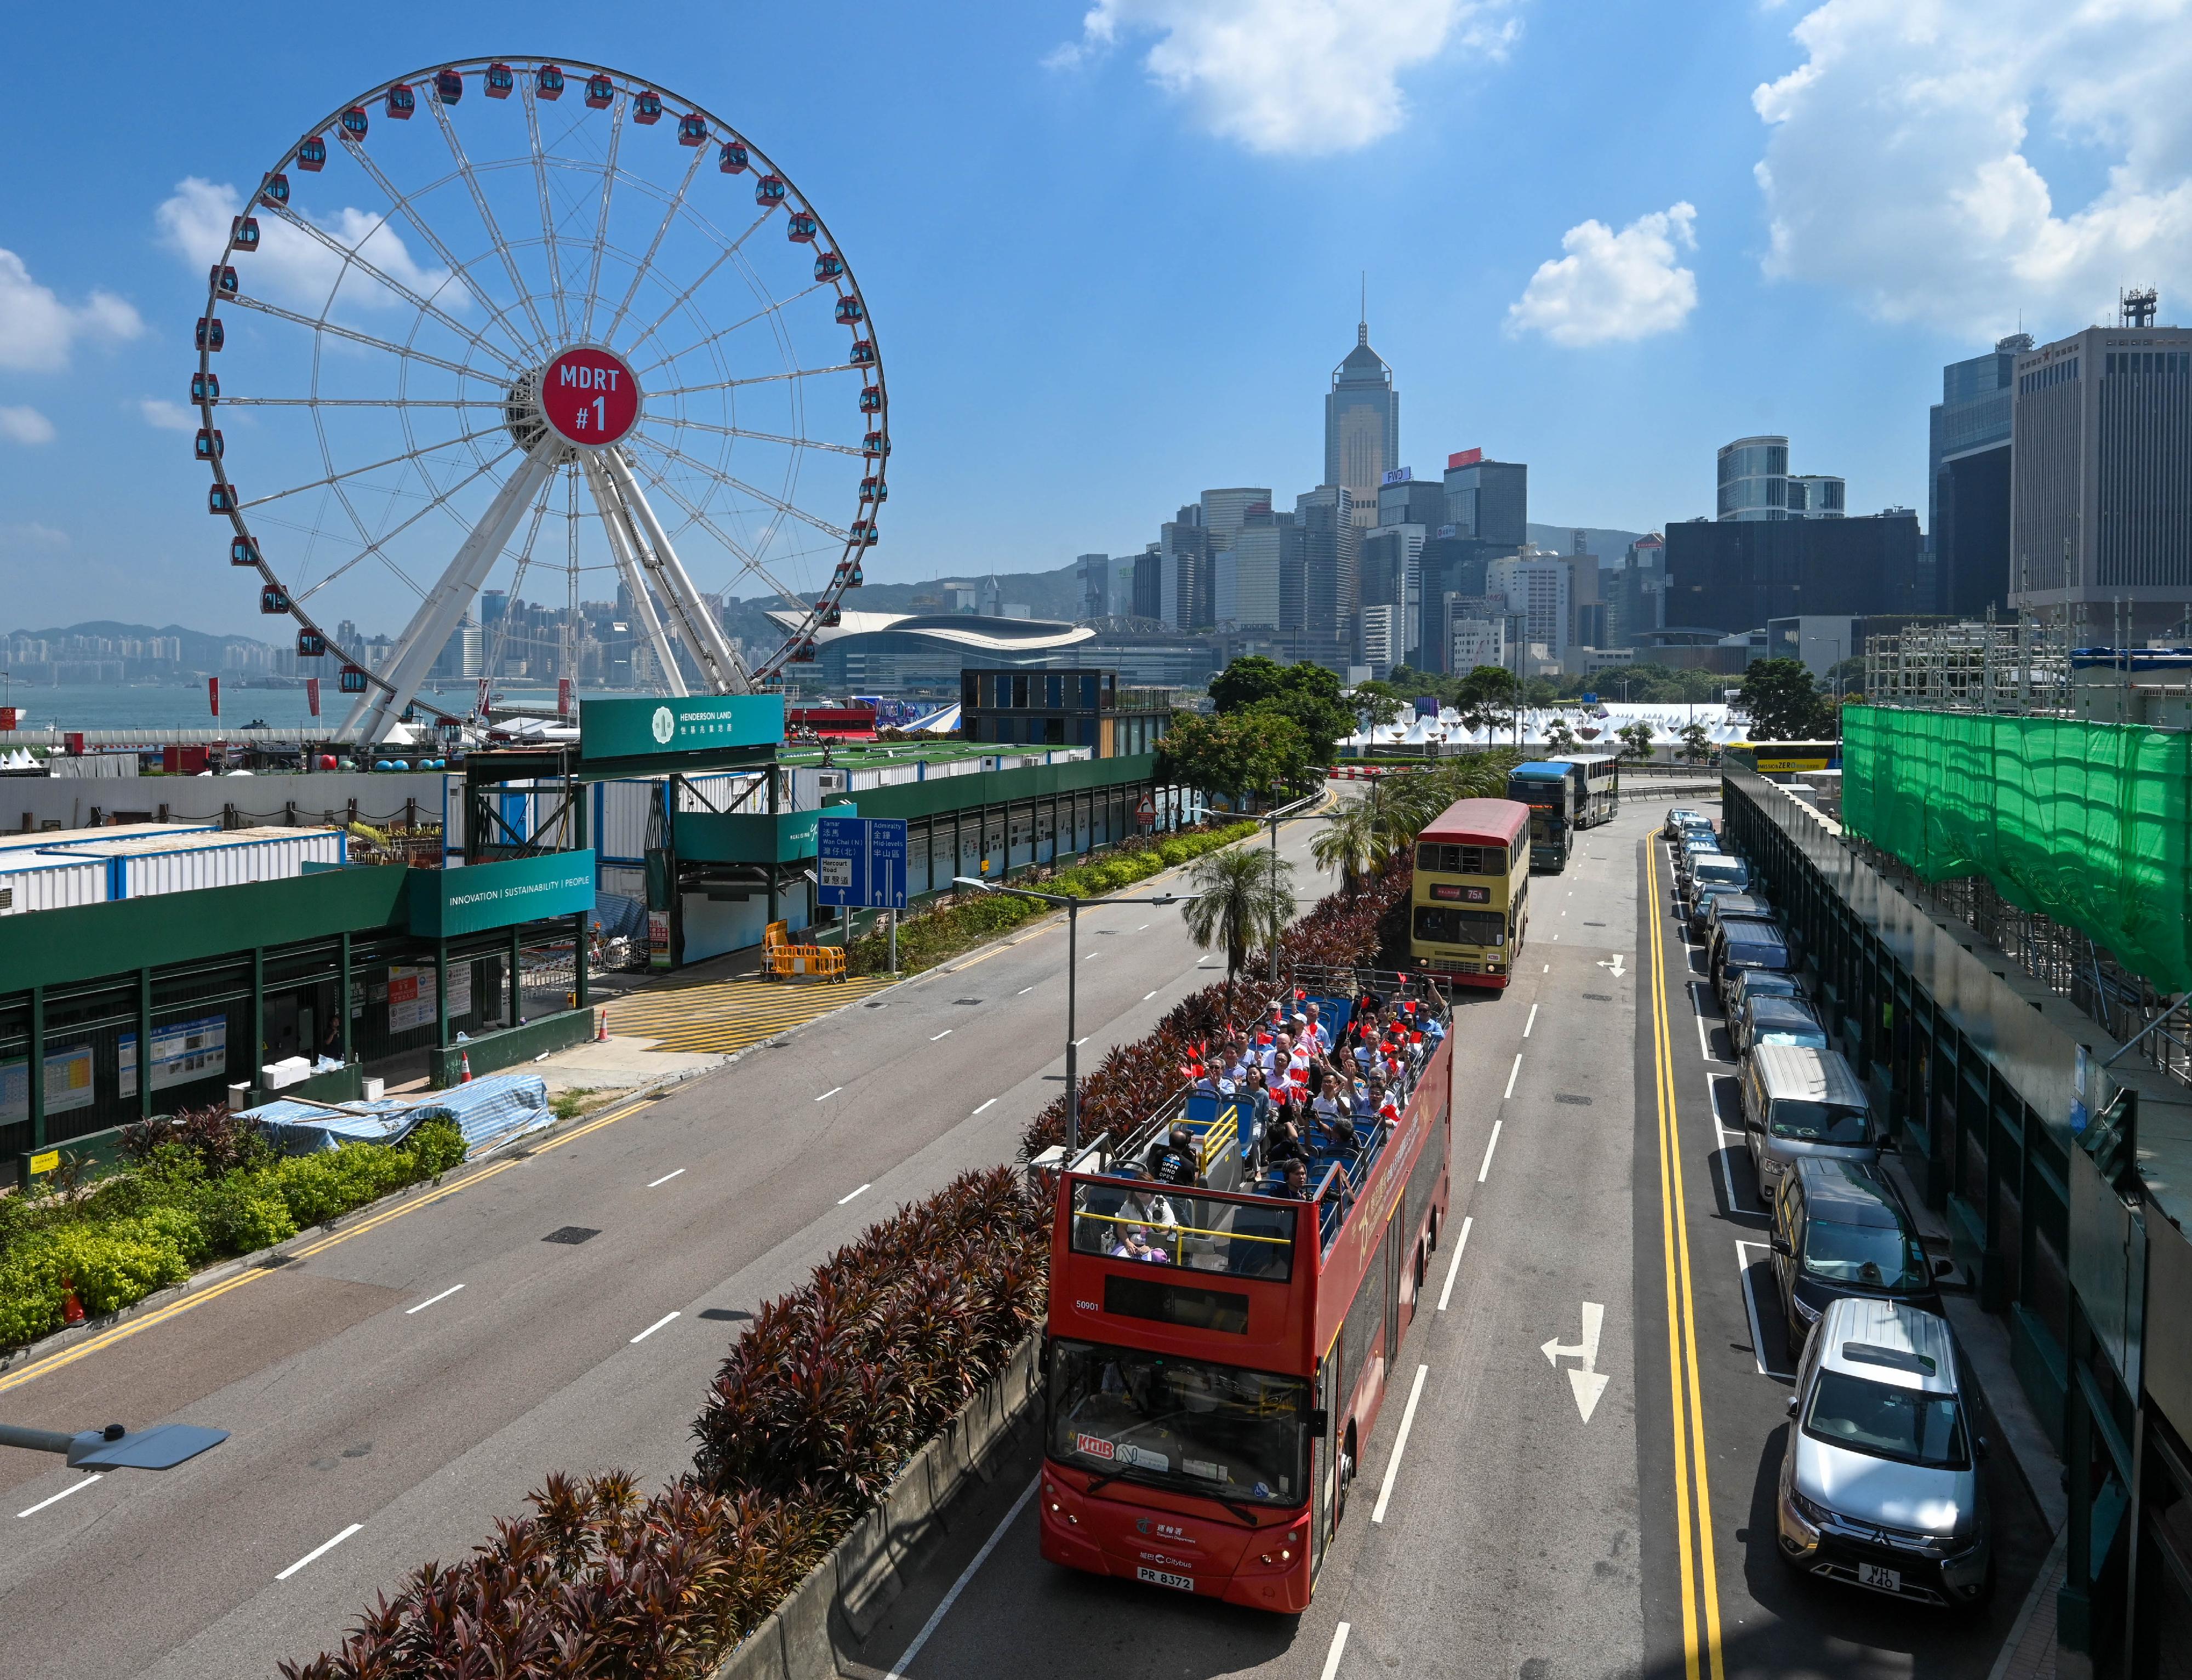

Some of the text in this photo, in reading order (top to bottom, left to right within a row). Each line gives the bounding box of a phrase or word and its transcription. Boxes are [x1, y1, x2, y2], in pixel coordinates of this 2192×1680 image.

[561, 364, 619, 391] MDRT
[576, 396, 605, 431] #1
[1388, 469, 1403, 482] FWD
[680, 712, 716, 721] HENDERSON
[681, 723, 732, 734] 恒基兆業地產
[790, 832, 810, 840] REALISING
[823, 828, 839, 837] 添馬
[874, 831, 891, 839] 金鐘
[874, 849, 900, 858] 半山區
[450, 876, 589, 906] INNOVATION SUSTAINABILITY PEOPLE
[1468, 889, 1483, 900] 75A
[1161, 1167, 1175, 1175] MIND
[1162, 1162, 1179, 1170] OPEN
[1159, 1172, 1174, 1180] OPEN
[1076, 1299, 1099, 1312] 50901
[1078, 1435, 1114, 1459] KMB
[1157, 1524, 1183, 1535] 運輸署
[1174, 1535, 1196, 1544] Department
[1140, 1551, 1154, 1561] 城巴
[1166, 1557, 1192, 1568] Citybus
[1871, 1566, 1888, 1579] WH
[1141, 1569, 1190, 1588] PR 8372
[1866, 1575, 1893, 1588] 440
